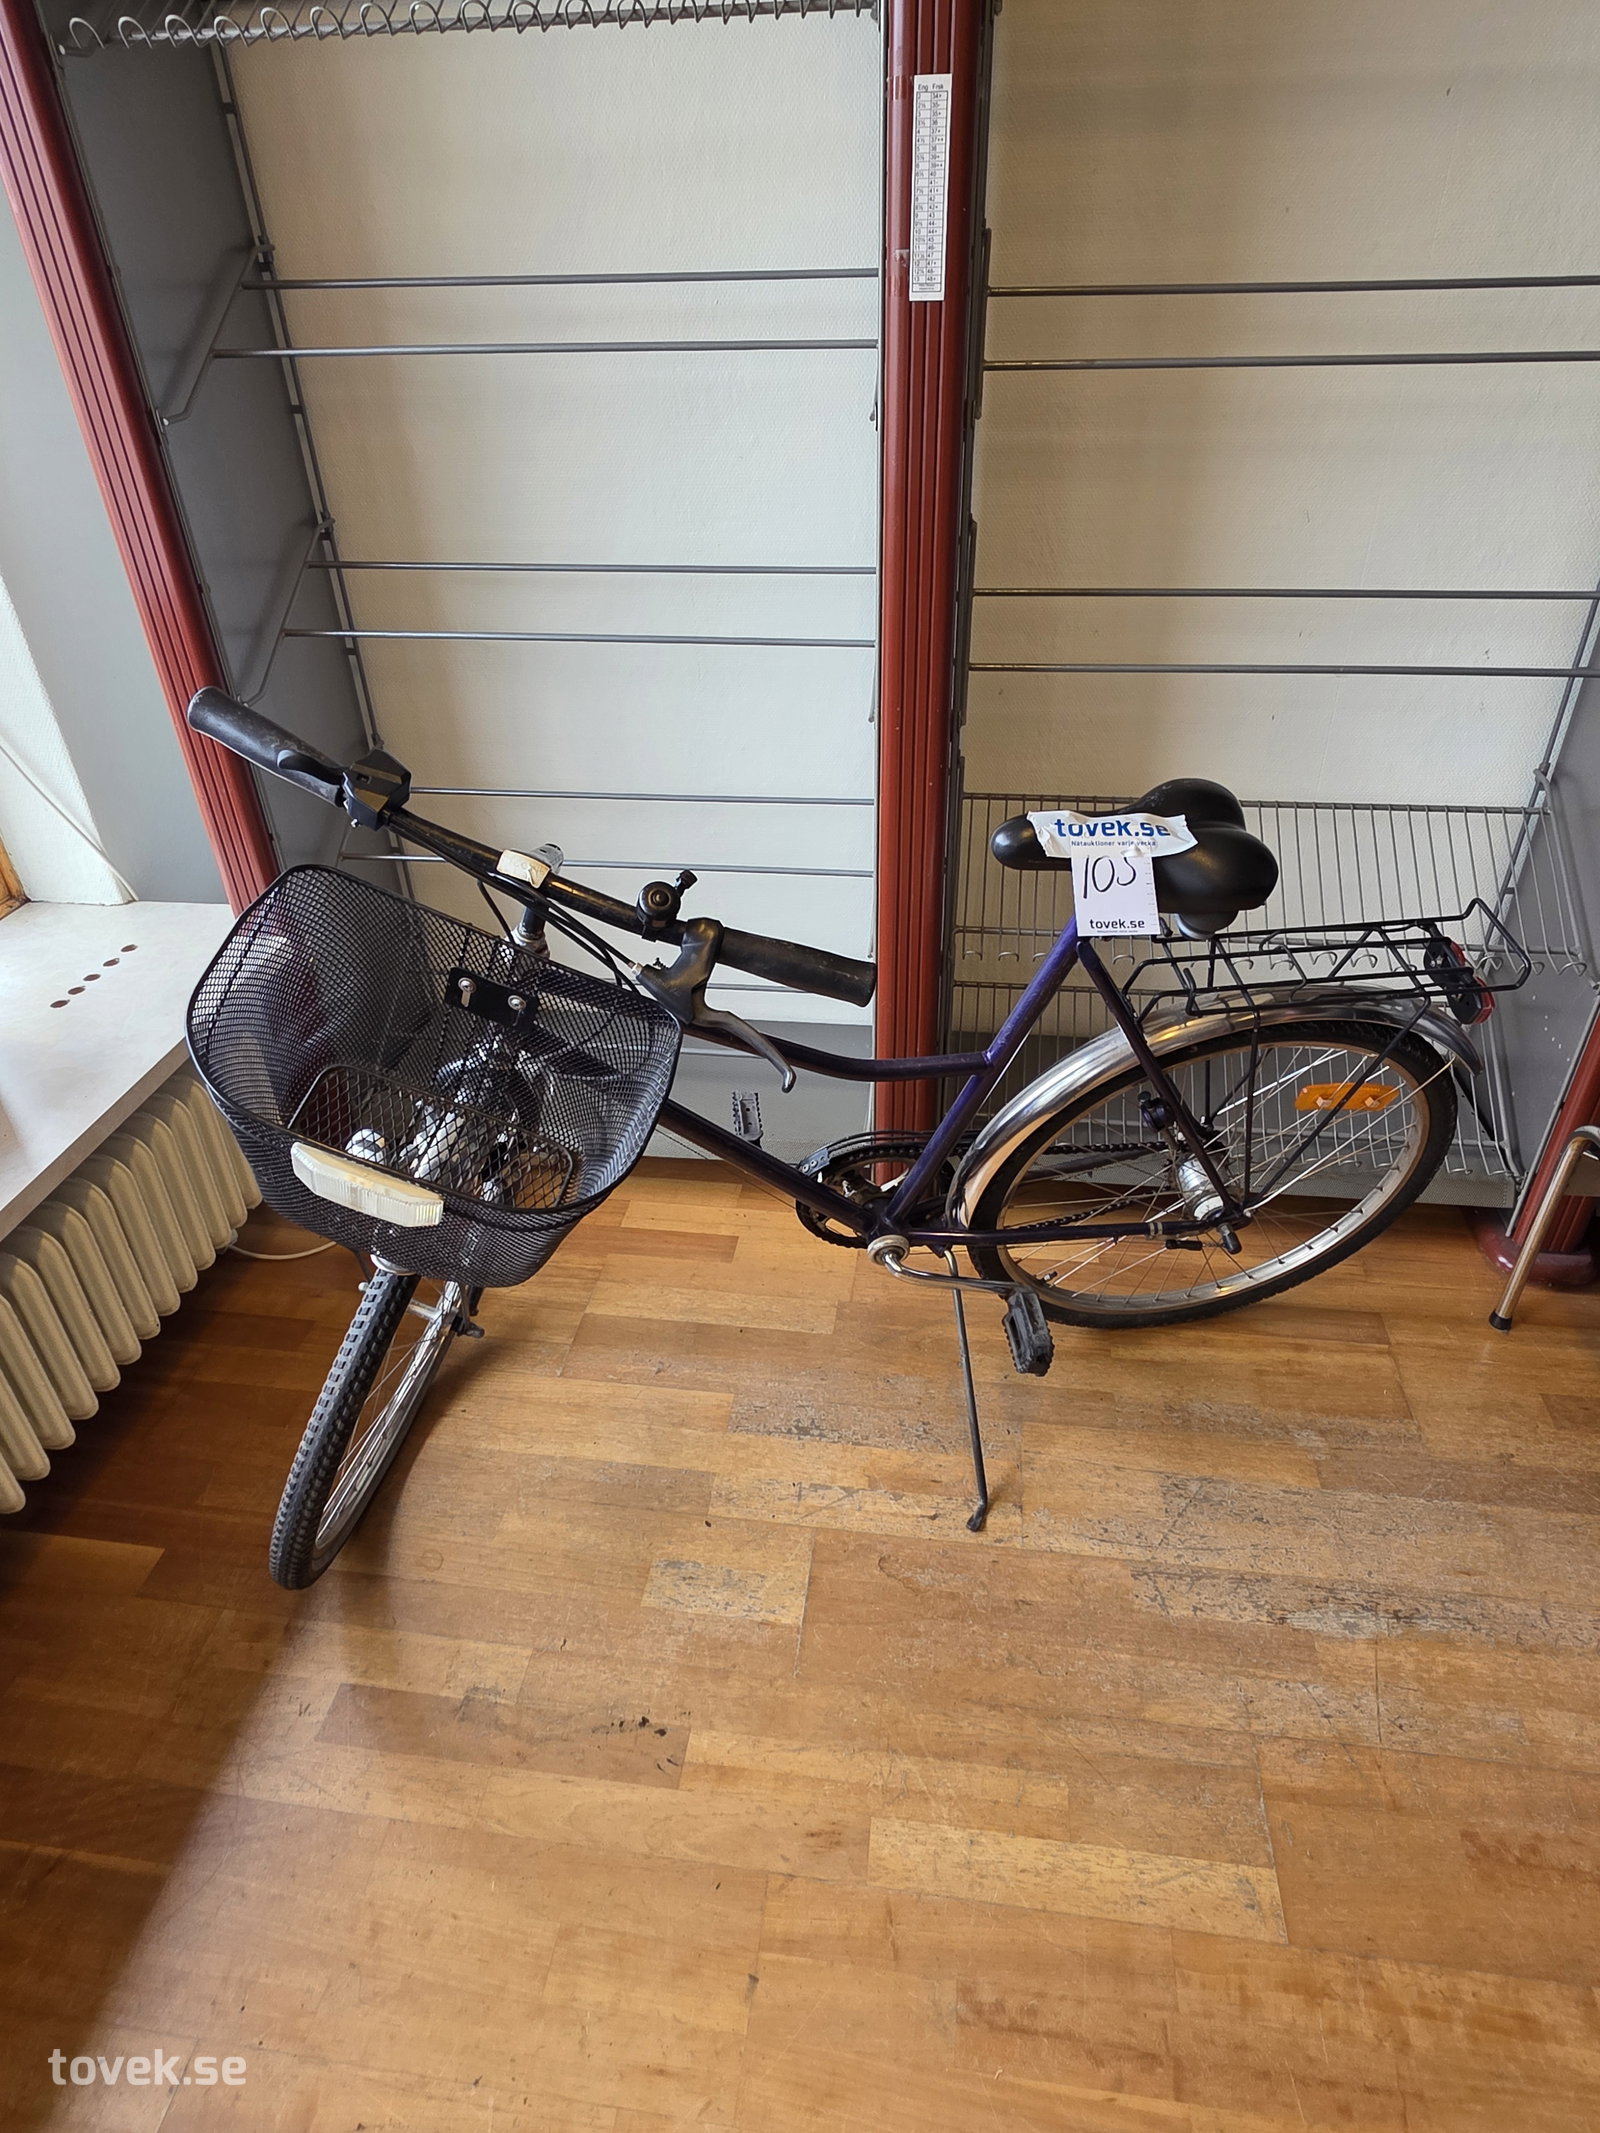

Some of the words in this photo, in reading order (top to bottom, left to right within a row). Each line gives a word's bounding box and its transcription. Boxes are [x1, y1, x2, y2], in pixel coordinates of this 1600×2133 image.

[918, 84, 928, 92] Eng
[1054, 818, 1171, 838] tovek.se
[1089, 918, 1146, 929] tovek.se
